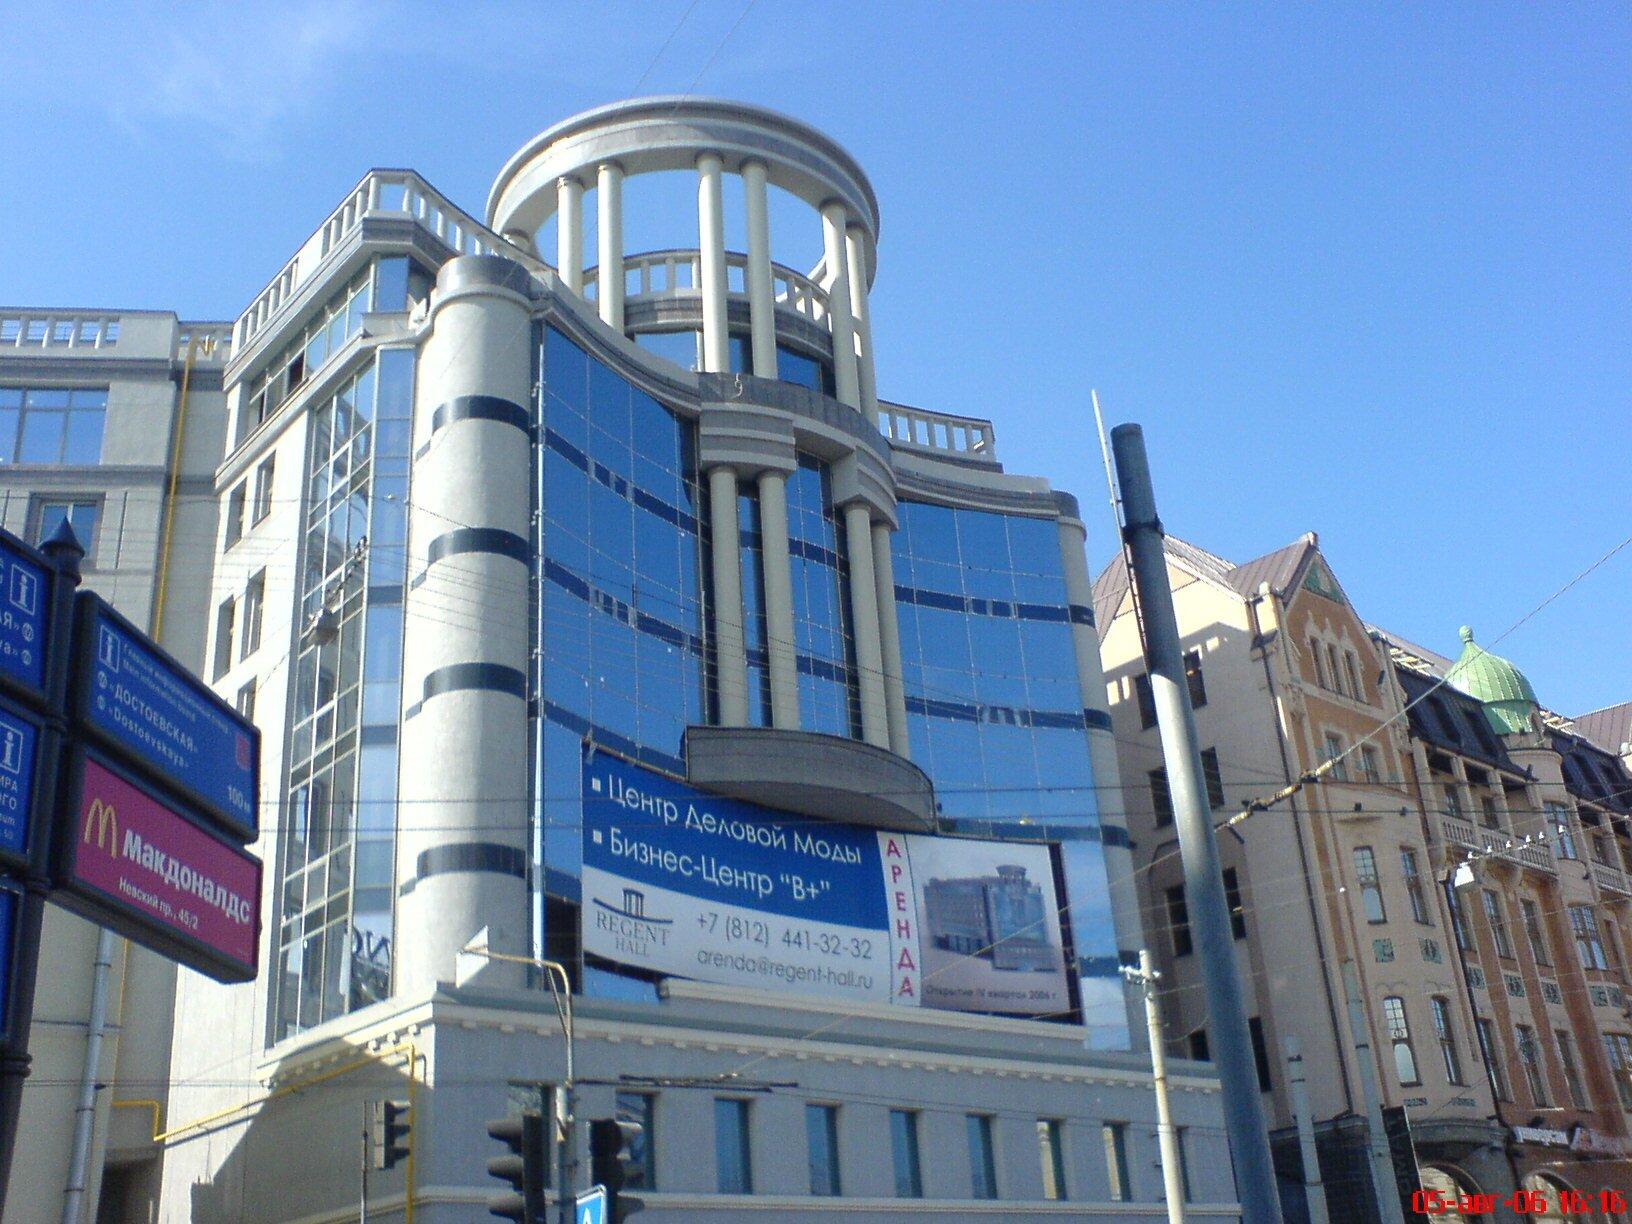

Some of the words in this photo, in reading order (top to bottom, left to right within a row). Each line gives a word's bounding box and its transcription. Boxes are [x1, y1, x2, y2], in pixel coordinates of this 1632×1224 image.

[608, 774, 678, 825] Центр
[685, 804, 787, 850] Деловой
[793, 830, 862, 864] Моды
[123, 829, 251, 924] Макдоналдс
[610, 827, 773, 898] Бизнес-Центр
[596, 910, 671, 946] REGENT
[697, 912, 718, 934] +7
[725, 915, 769, 948] (812)
[782, 928, 872, 960] 441-32-32
[887, 838, 916, 997] АРЕНДА
